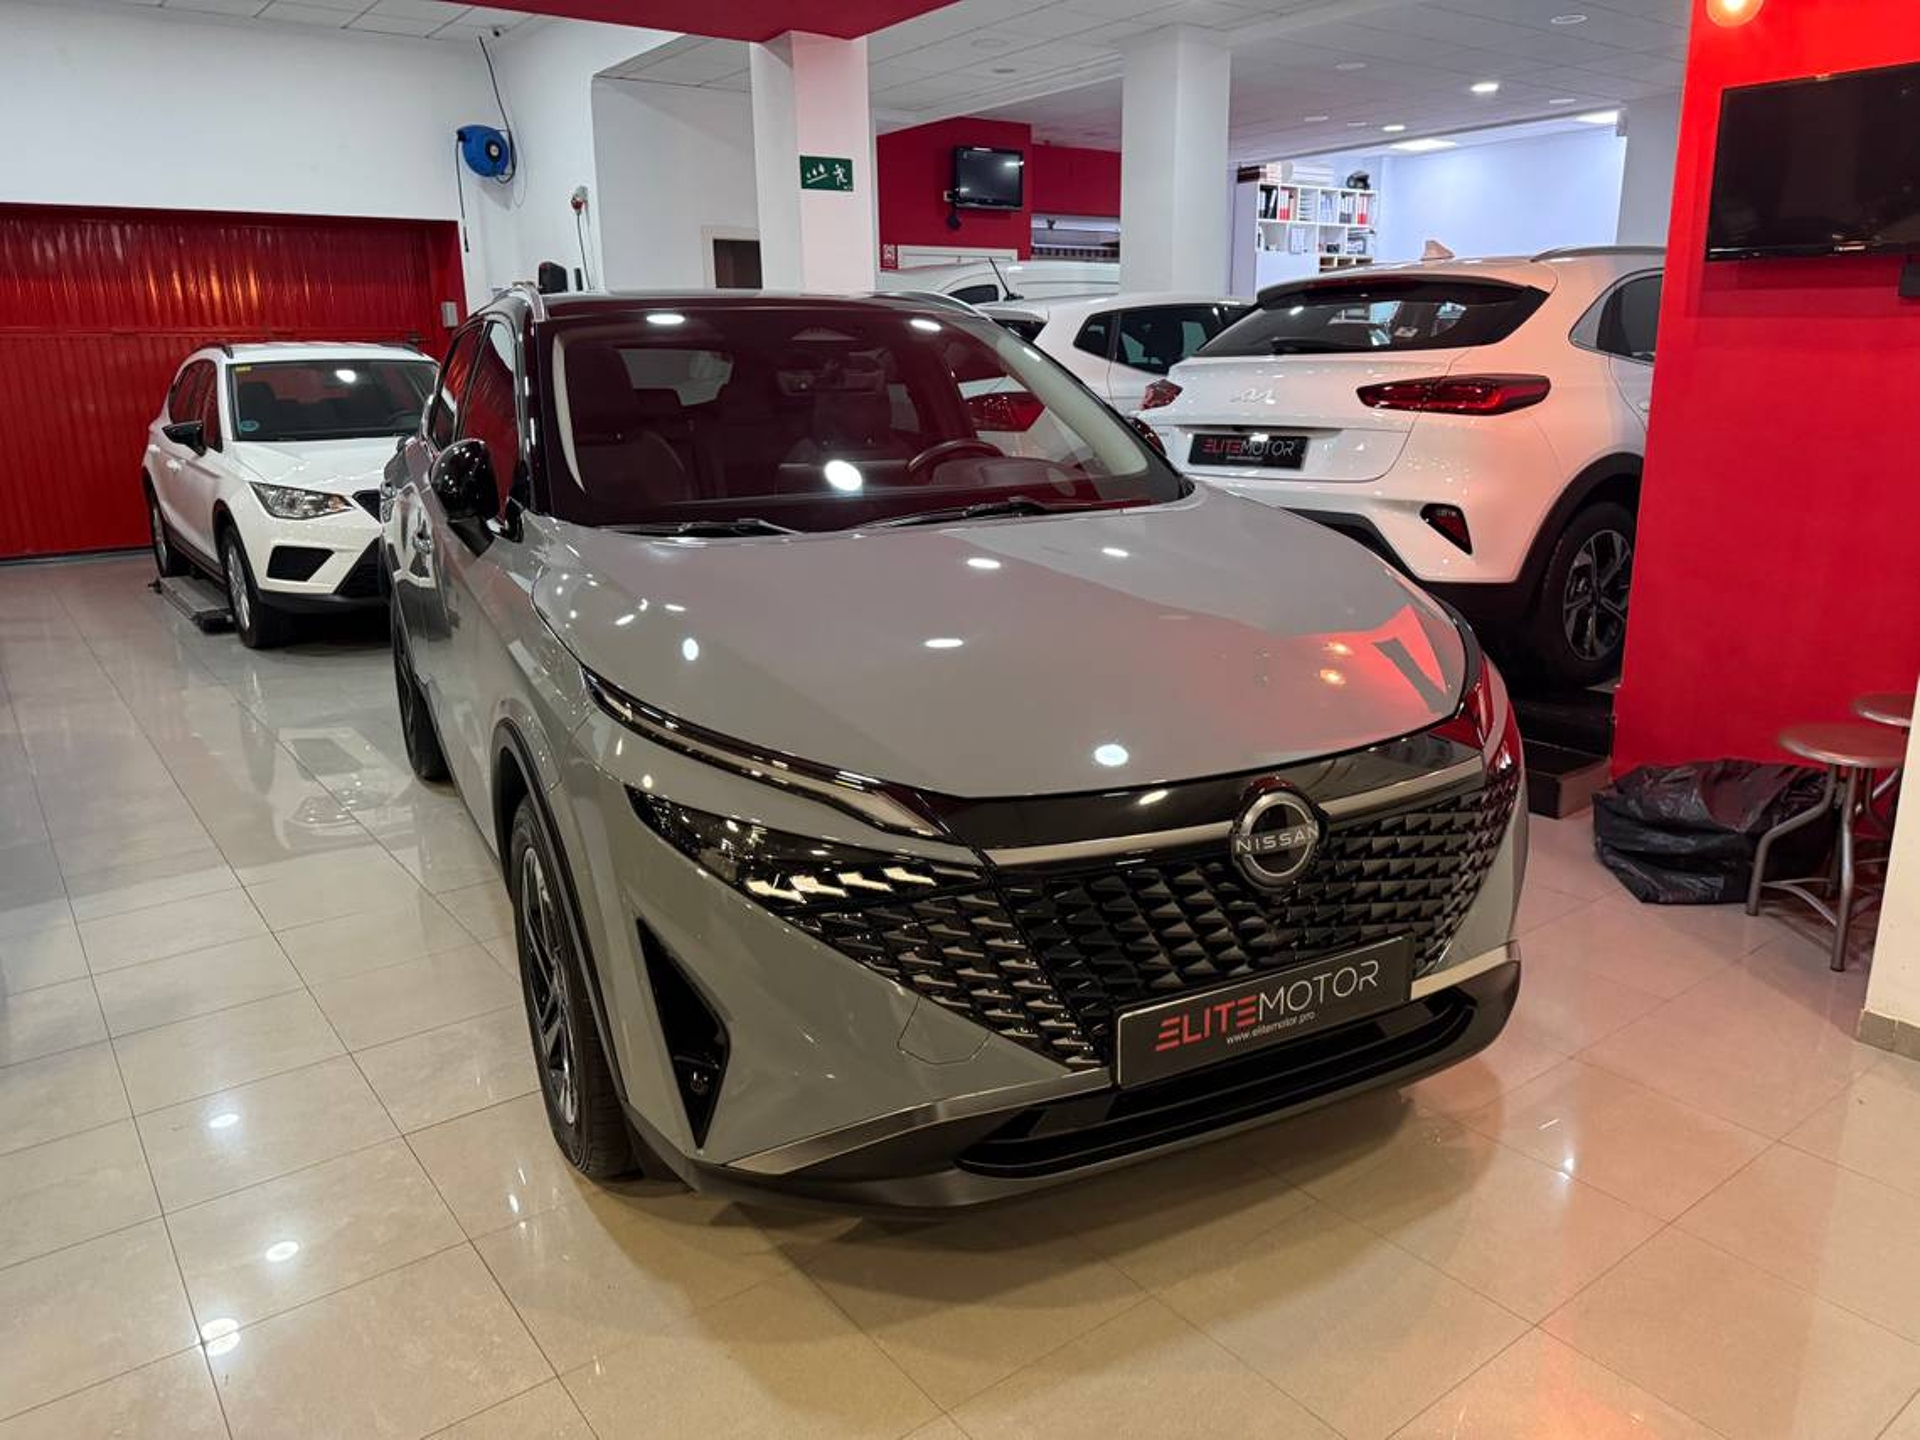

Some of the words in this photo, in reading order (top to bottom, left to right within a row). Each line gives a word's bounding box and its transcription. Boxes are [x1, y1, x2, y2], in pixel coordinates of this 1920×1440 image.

[1202, 438, 1295, 456] ELITEMOTOR
[1236, 820, 1319, 852] NISSAN
[1156, 960, 1379, 1051] ELITEMOTOR
[1226, 1011, 1316, 1044] www.elitemotor.pro
